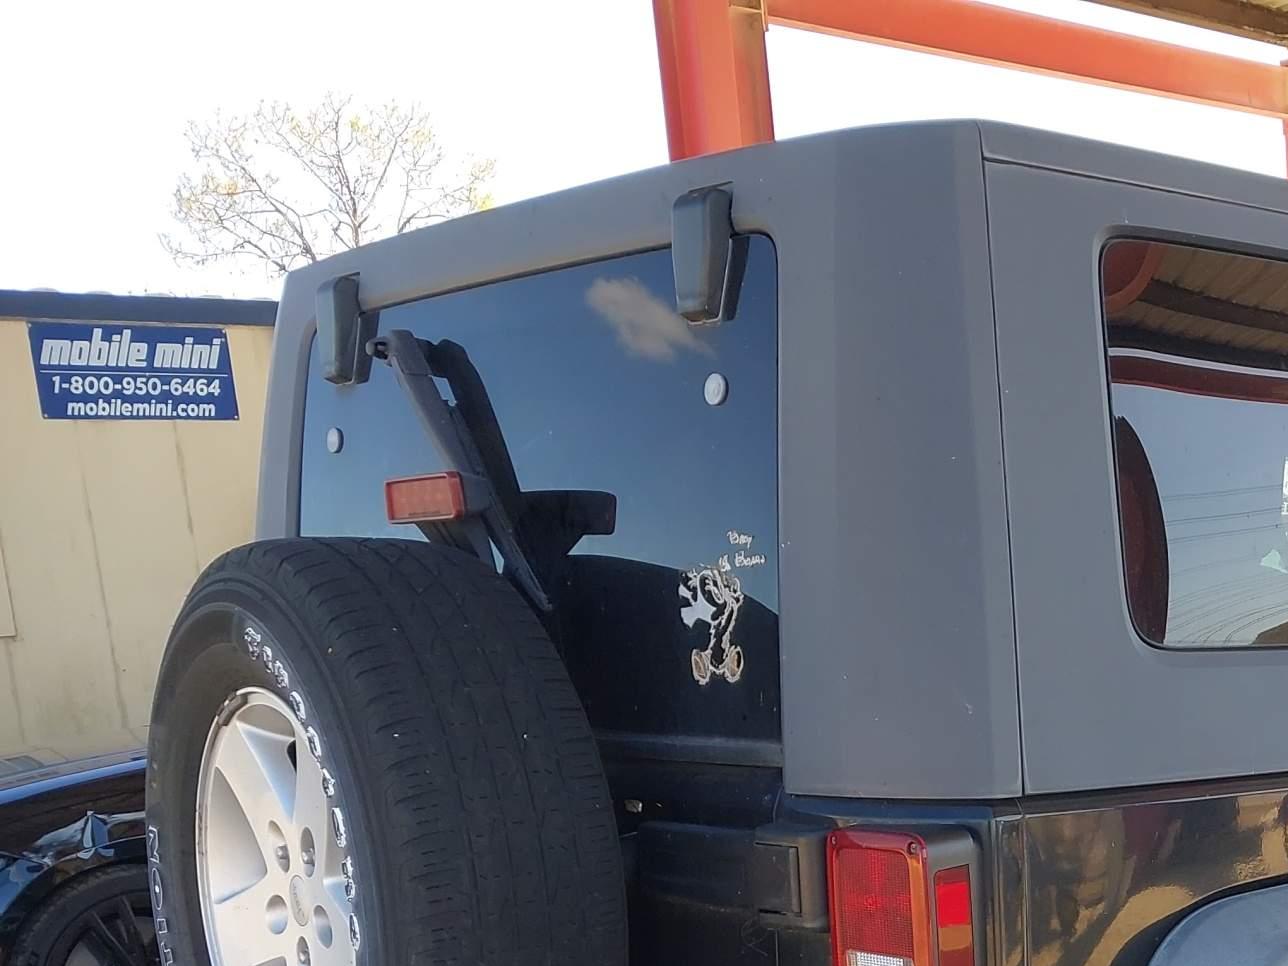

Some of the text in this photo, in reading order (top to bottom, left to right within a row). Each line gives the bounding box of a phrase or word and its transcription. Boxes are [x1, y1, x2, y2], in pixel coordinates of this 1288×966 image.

[39, 328, 222, 369] mobile mini
[51, 375, 222, 397] 1-800-950-6464
[66, 399, 216, 417] mobilemini.com
